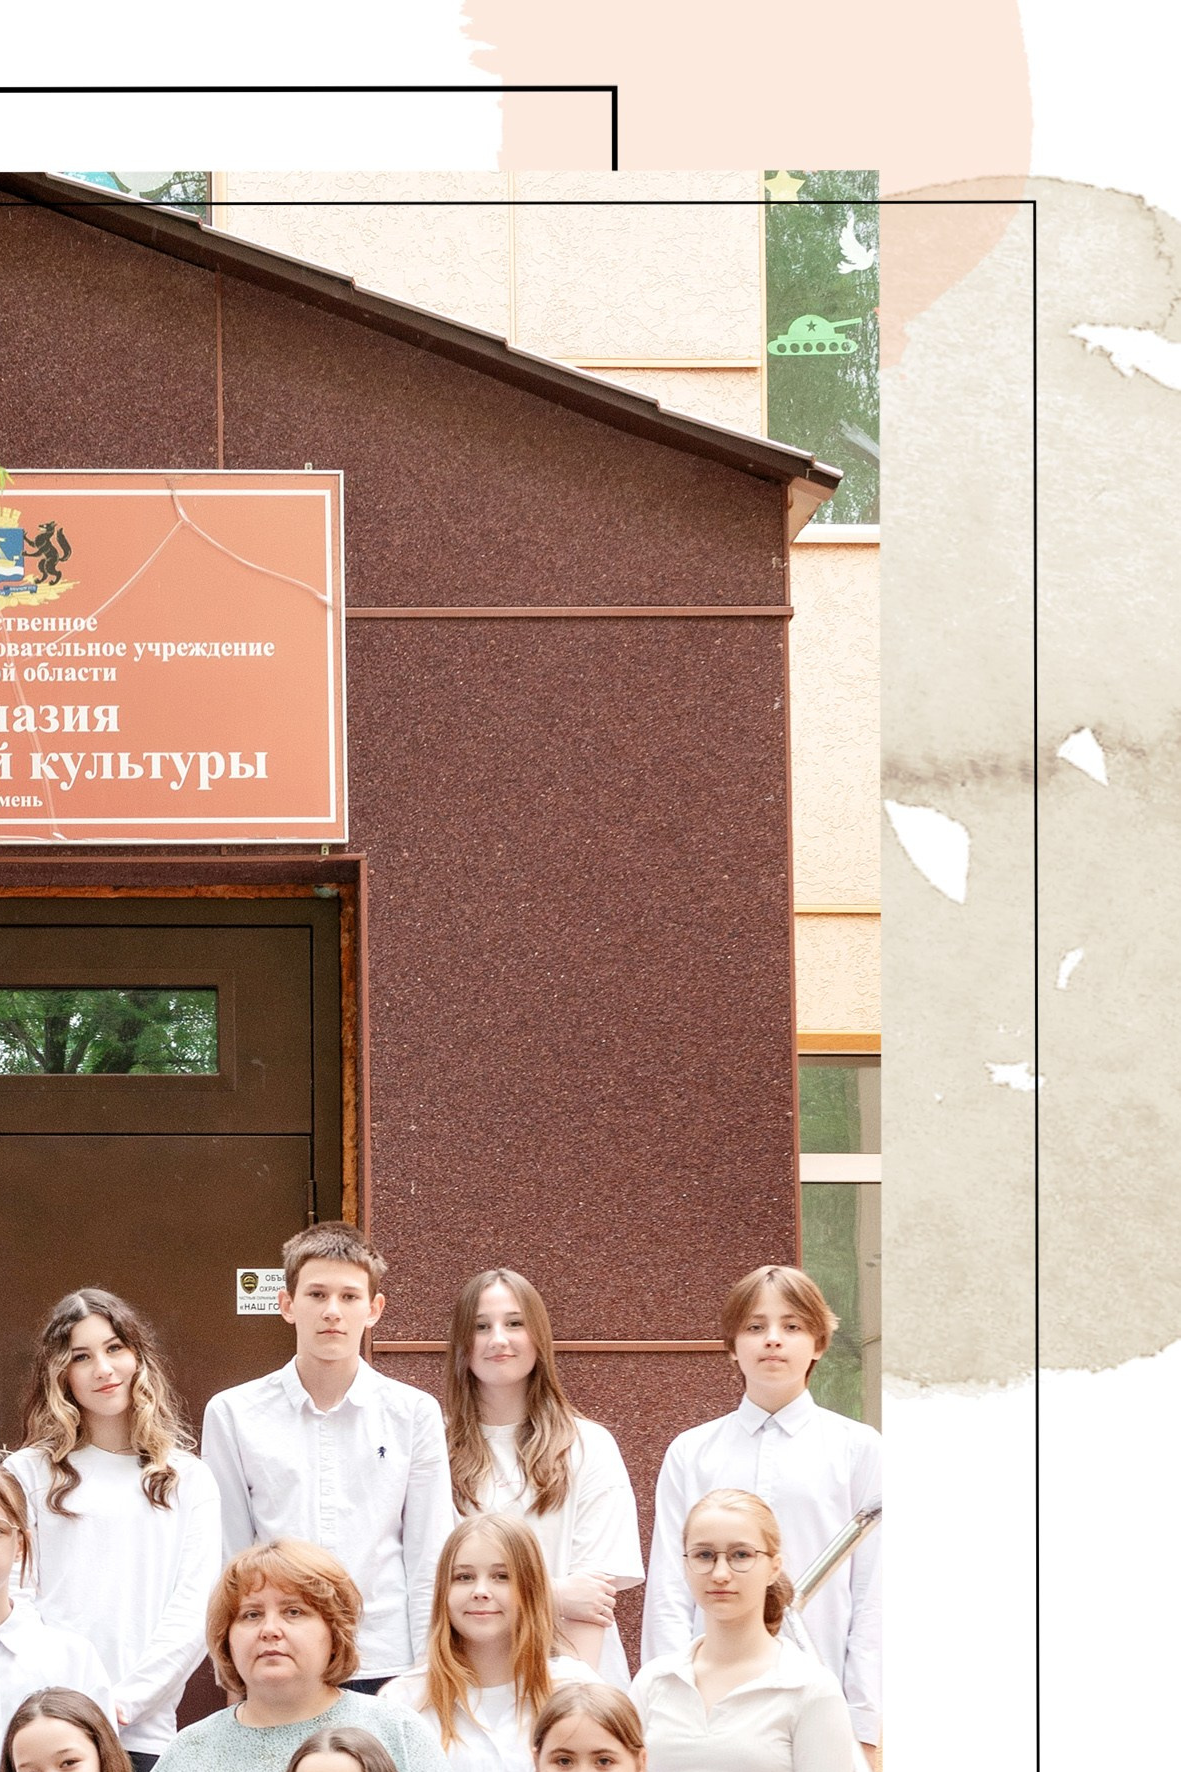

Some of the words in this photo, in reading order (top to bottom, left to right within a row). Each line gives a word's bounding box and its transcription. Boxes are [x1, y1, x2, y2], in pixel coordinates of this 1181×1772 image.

[133, 642, 275, 661] учреждение
[23, 662, 117, 682] области
[29, 750, 269, 791] культуры
[265, 1274, 286, 1282] ОБЪЕ
